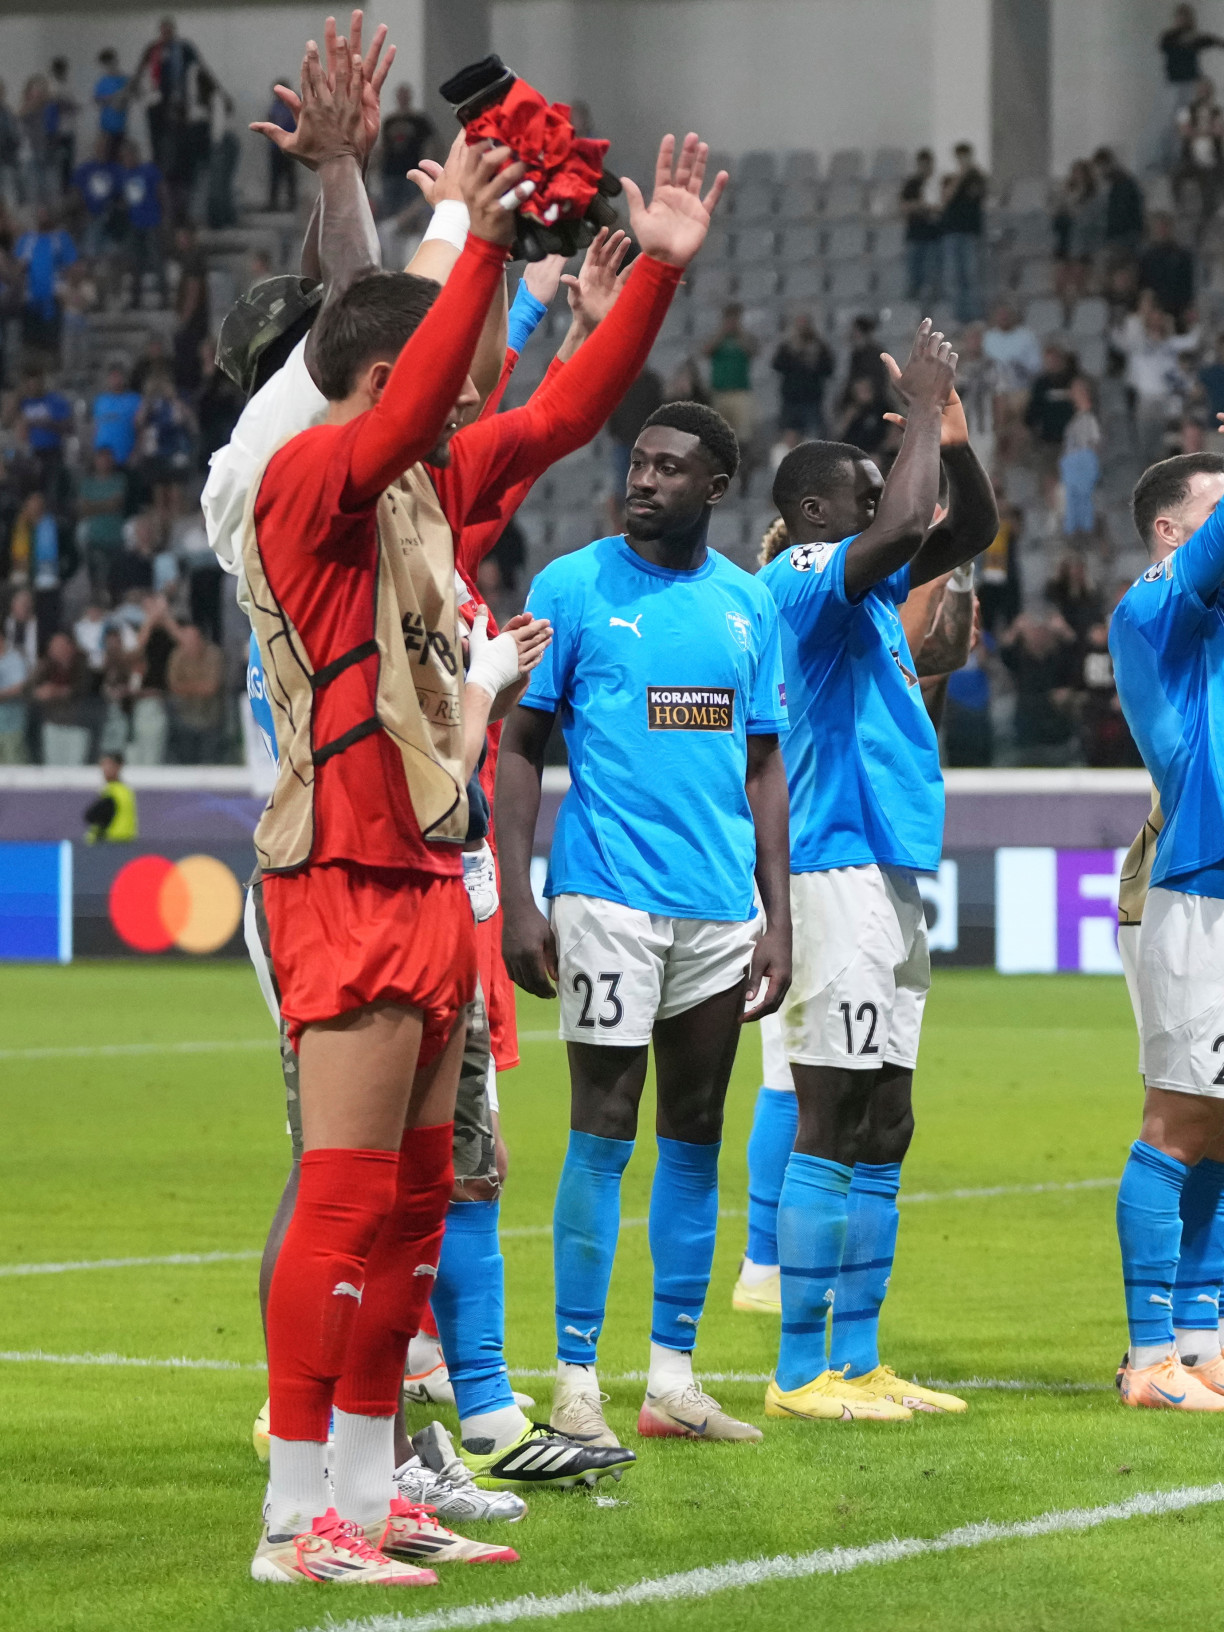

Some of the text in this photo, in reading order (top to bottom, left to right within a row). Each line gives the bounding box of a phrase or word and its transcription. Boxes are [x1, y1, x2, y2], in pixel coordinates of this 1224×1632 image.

[651, 691, 730, 705] KORANTINA
[653, 706, 729, 727] HOMES
[572, 972, 624, 1029] 23
[839, 1000, 879, 1056] 12
